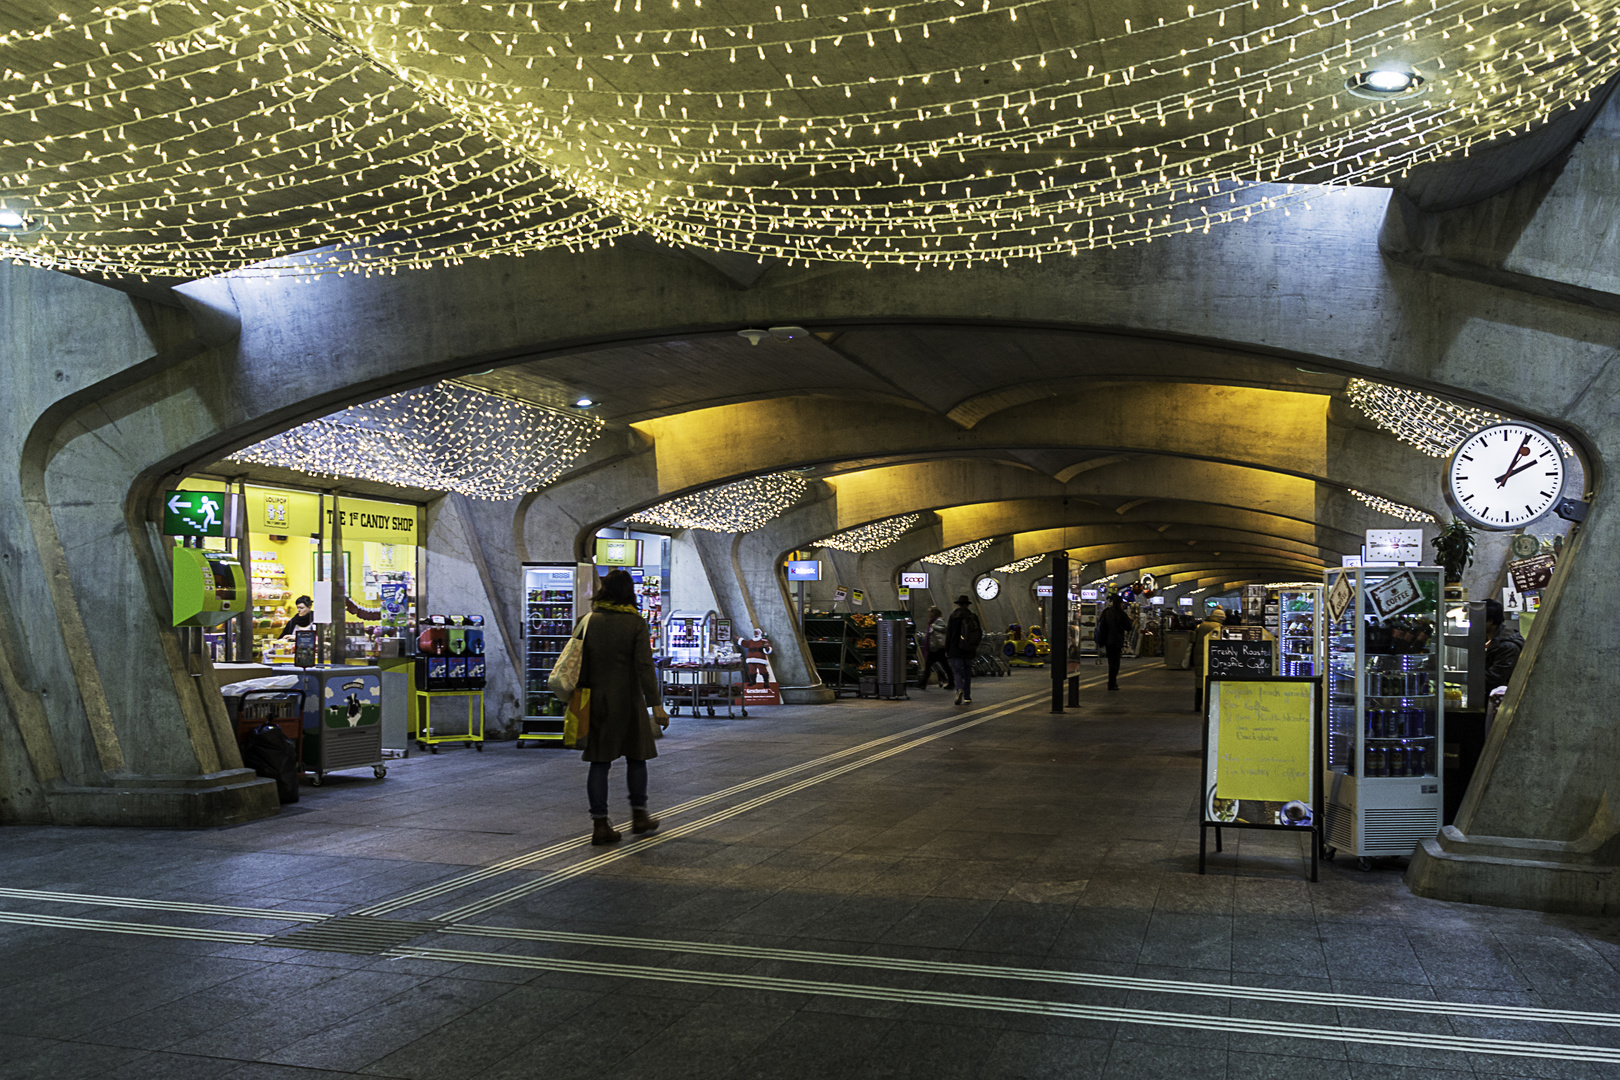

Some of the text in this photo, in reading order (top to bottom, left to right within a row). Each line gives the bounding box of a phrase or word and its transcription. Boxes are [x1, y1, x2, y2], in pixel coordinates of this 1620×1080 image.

[326, 509, 346, 526] TE
[360, 513, 390, 530] CANDY
[392, 517, 414, 531] SHOP
[904, 576, 925, 584] coop
[1385, 590, 1410, 607] COFFEE
[1210, 645, 1238, 658] Freshly
